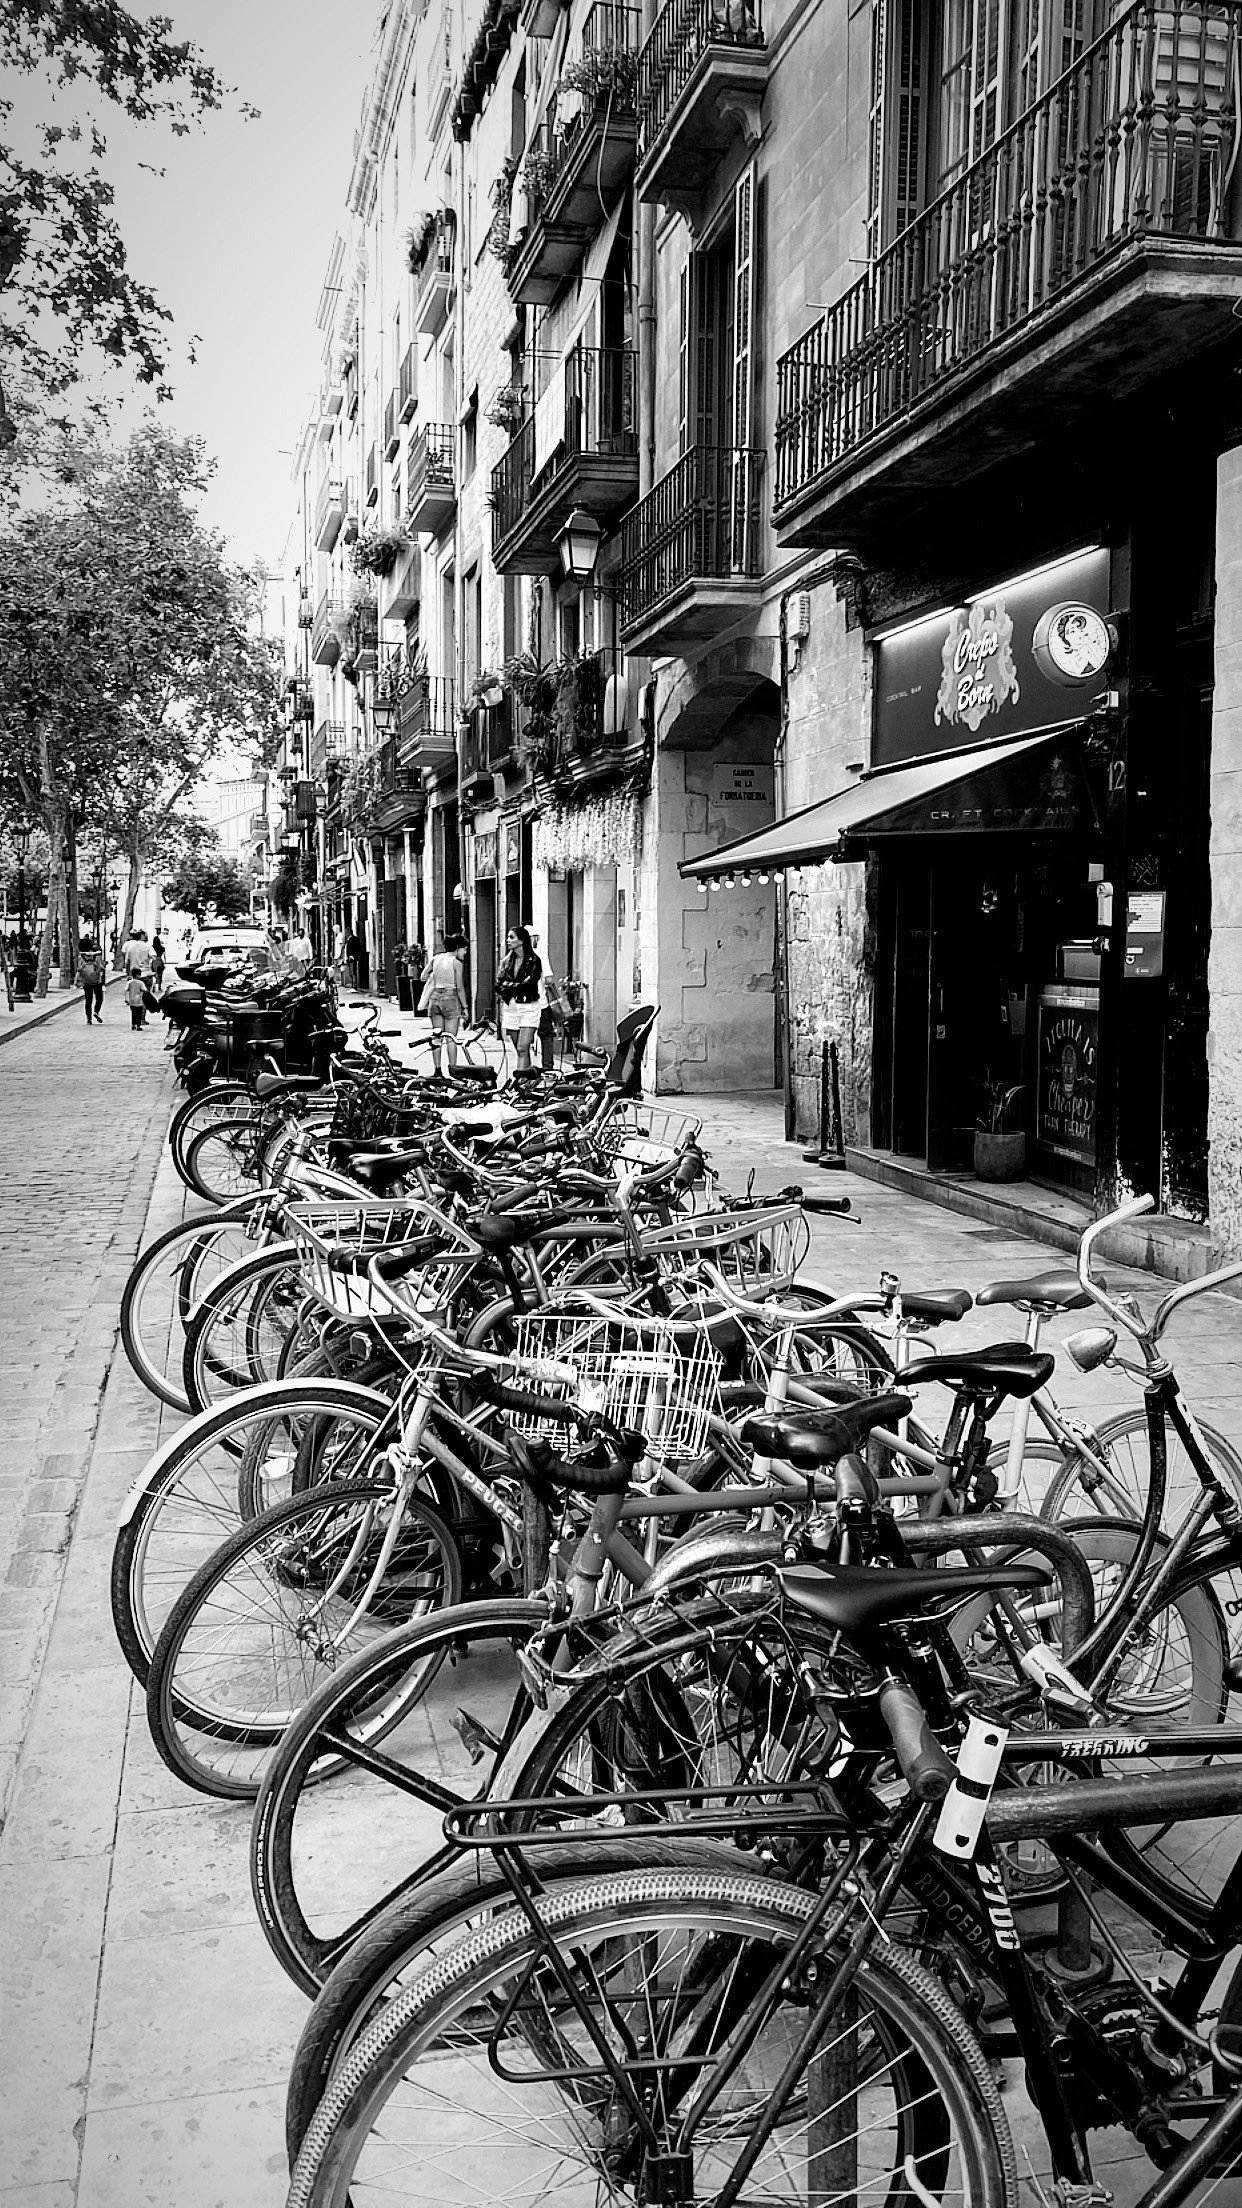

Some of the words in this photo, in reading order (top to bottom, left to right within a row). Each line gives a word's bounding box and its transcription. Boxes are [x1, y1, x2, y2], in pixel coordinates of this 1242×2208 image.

[953, 628, 999, 674] Creps
[957, 674, 994, 711] Born
[1107, 760, 1126, 791] 12
